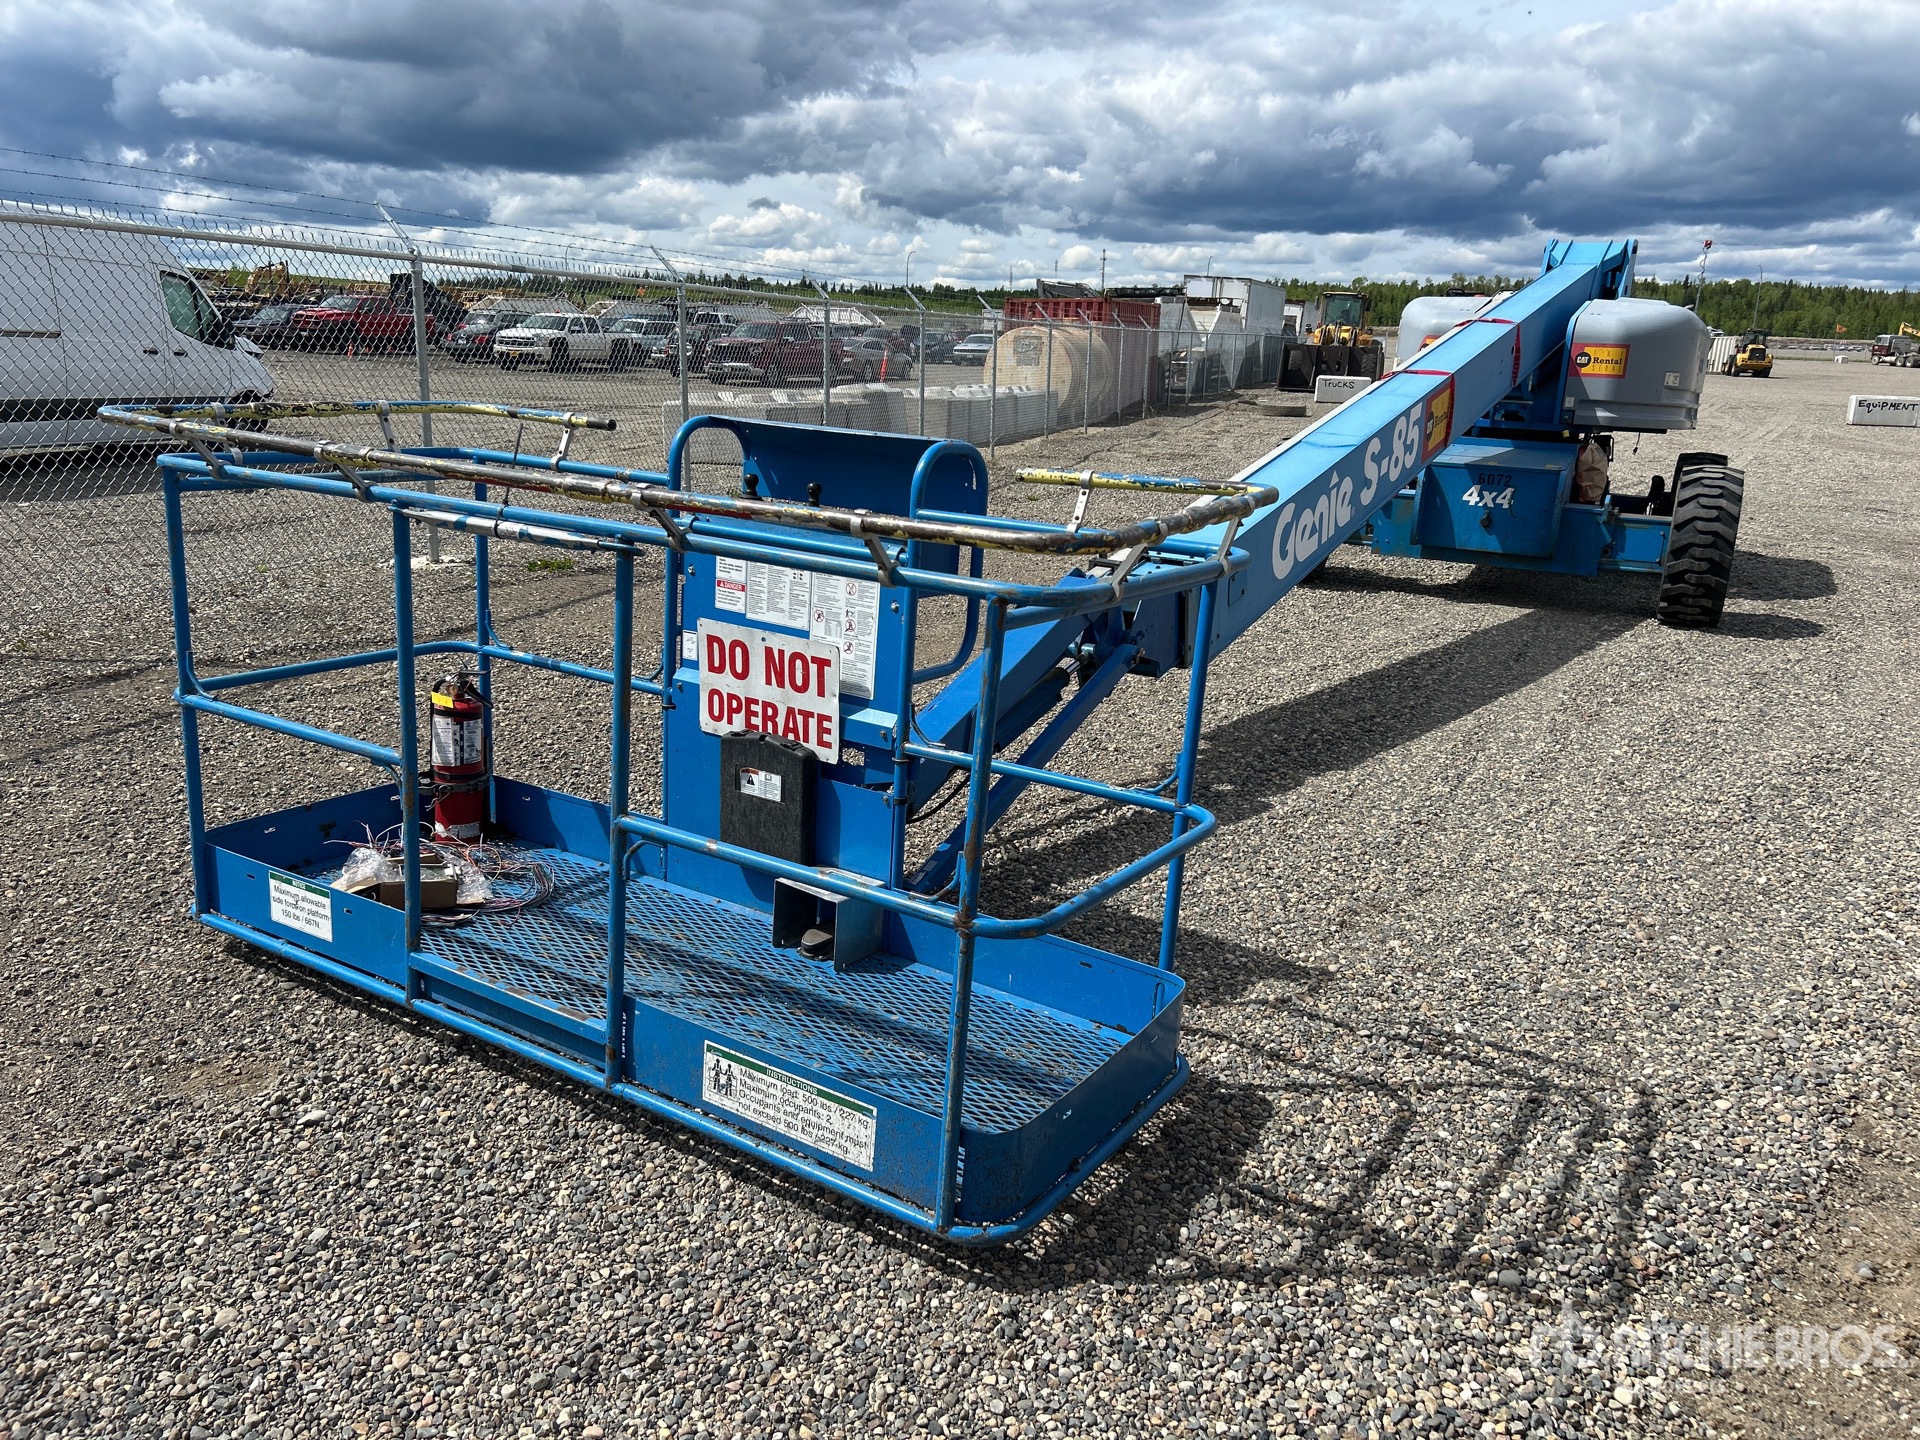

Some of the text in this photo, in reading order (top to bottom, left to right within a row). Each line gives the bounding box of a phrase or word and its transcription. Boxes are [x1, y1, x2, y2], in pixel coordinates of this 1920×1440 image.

[1576, 356, 1623, 365] CAT Rental
[1272, 402, 1422, 580] Genie S-85
[1478, 472, 1512, 488] 6072
[1462, 484, 1515, 509] 4x4
[724, 581, 742, 591] DANGER
[706, 634, 750, 681] DO
[764, 645, 832, 698] NOT
[707, 688, 833, 749] OPERATE
[272, 896, 284, 905] side
[299, 905, 307, 913] on
[273, 885, 326, 910] Maximum allowable
[281, 908, 291, 918] 150
[292, 912, 301, 921] lbs
[304, 917, 319, 928] 667N
[739, 1067, 778, 1090] Maximum
[780, 1084, 800, 1099] load:
[802, 1094, 818, 1106] 500
[820, 1100, 832, 1112] lbs
[839, 1108, 856, 1121] 227
[767, 1068, 818, 1095] INSTRUCTIONS
[739, 1078, 777, 1100] Maximum
[779, 1096, 824, 1120] occupants:
[738, 1101, 751, 1112] not
[753, 1107, 781, 1125] exceed
[783, 1119, 799, 1132] 500
[800, 1125, 813, 1138] lbs
[820, 1134, 836, 1148] 227
[739, 1089, 867, 1150] Occupants and equipment must
